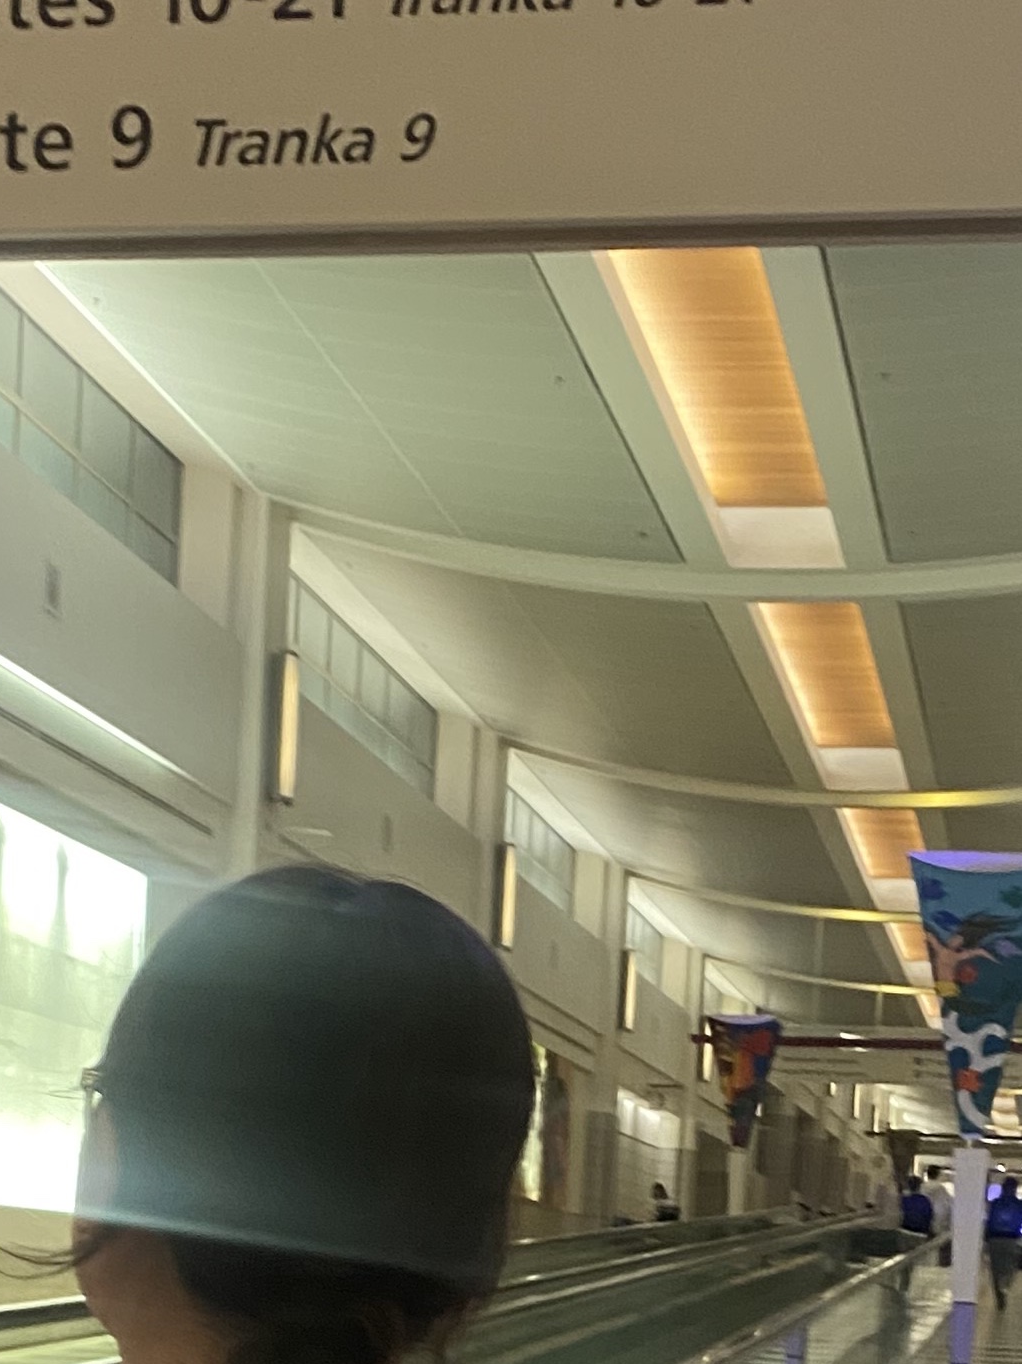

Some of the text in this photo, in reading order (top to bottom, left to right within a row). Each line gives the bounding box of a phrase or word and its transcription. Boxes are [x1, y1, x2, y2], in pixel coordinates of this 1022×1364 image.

[110, 103, 154, 172] 9
[194, 111, 377, 168] Tranka
[398, 111, 439, 164] 9
